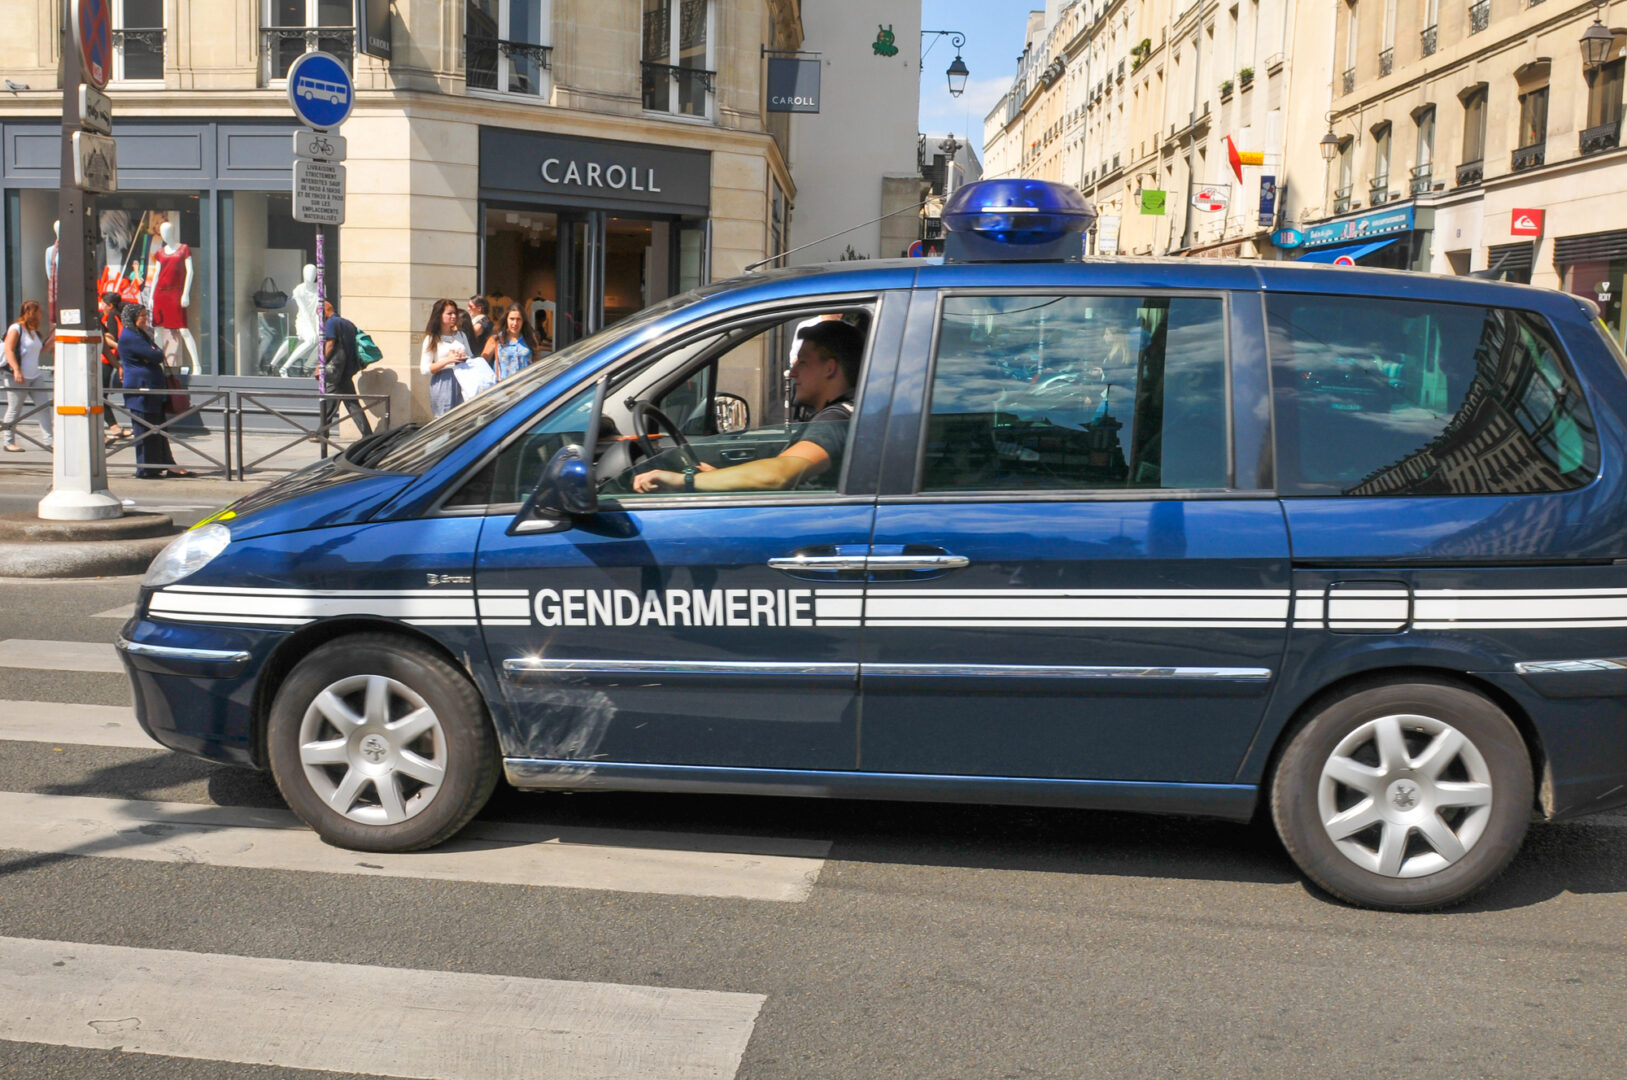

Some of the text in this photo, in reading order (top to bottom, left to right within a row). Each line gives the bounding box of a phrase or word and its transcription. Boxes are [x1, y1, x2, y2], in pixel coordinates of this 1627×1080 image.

[772, 96, 815, 106] CAROLL
[541, 158, 661, 193] CAROLL
[533, 588, 811, 626] GENDARMERIE
